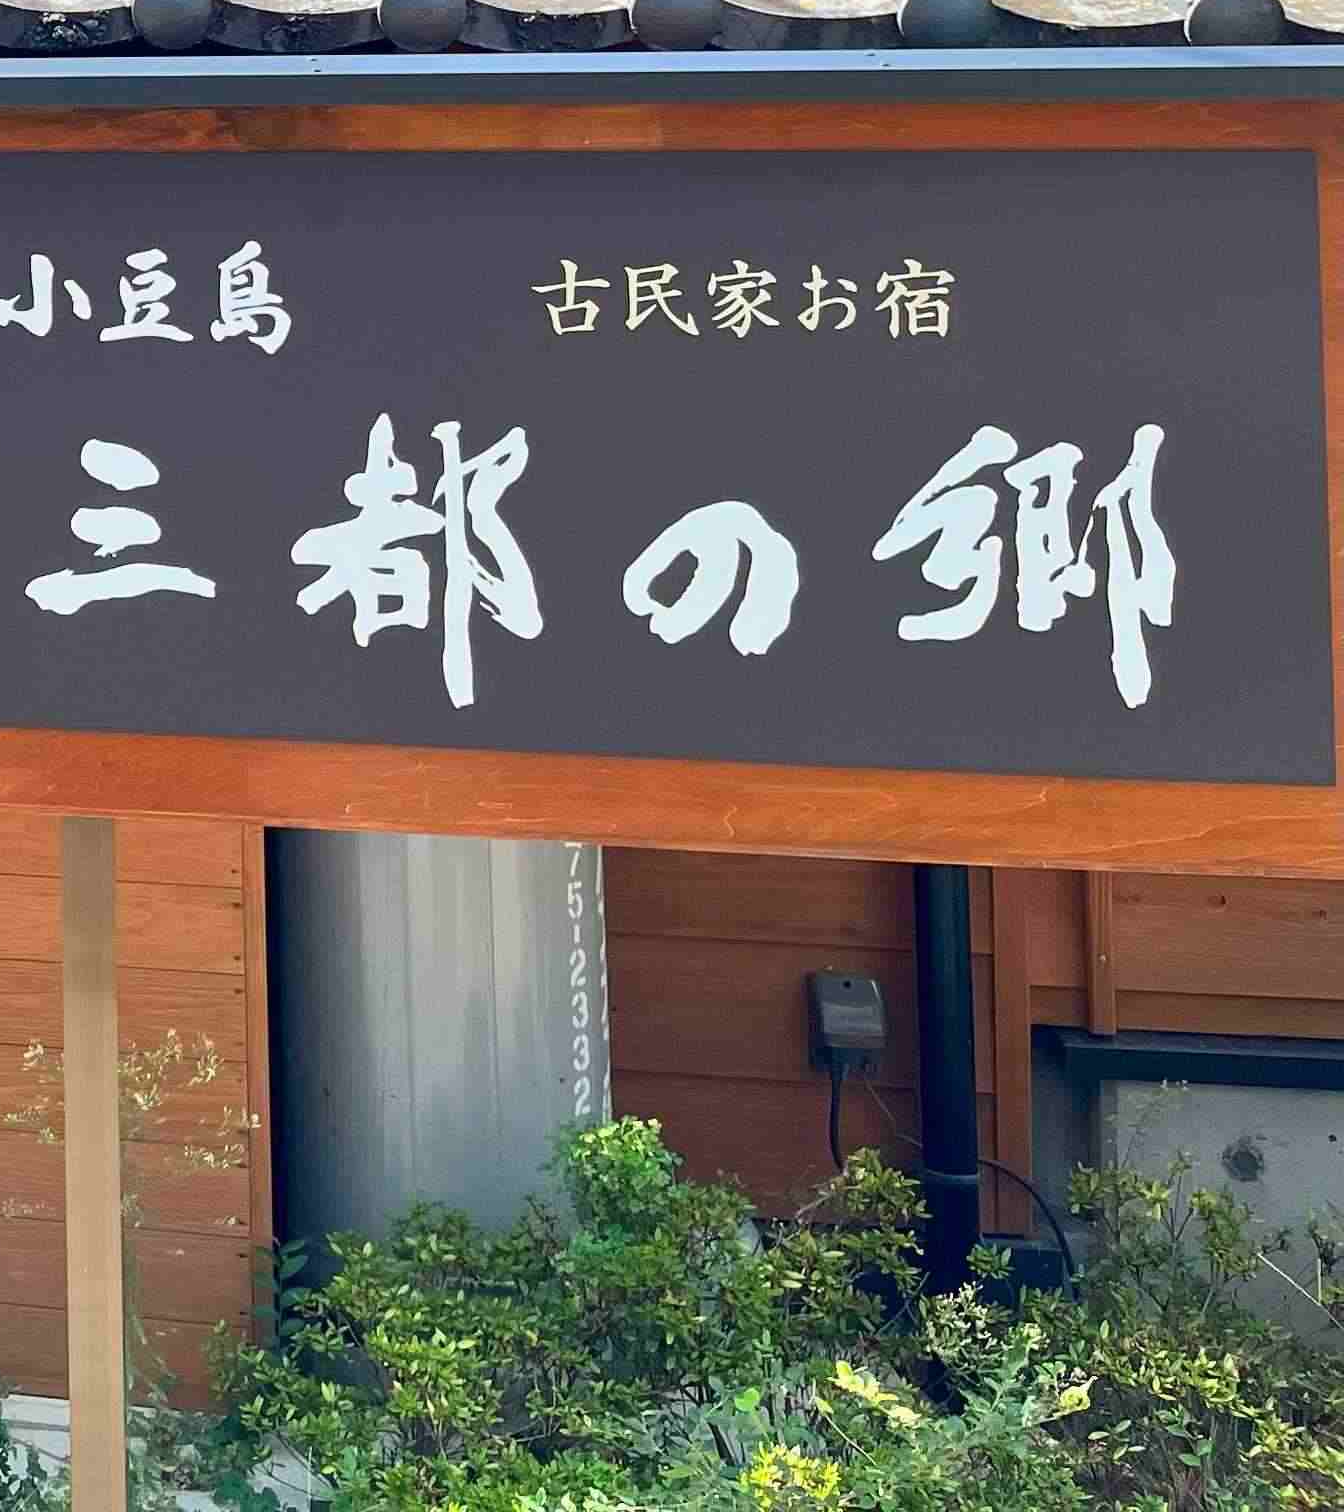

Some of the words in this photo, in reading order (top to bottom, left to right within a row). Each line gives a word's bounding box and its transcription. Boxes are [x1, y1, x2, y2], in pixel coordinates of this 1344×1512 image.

[529, 257, 957, 340] 古民家お宿
[23, 410, 1178, 710] 三都の郷
